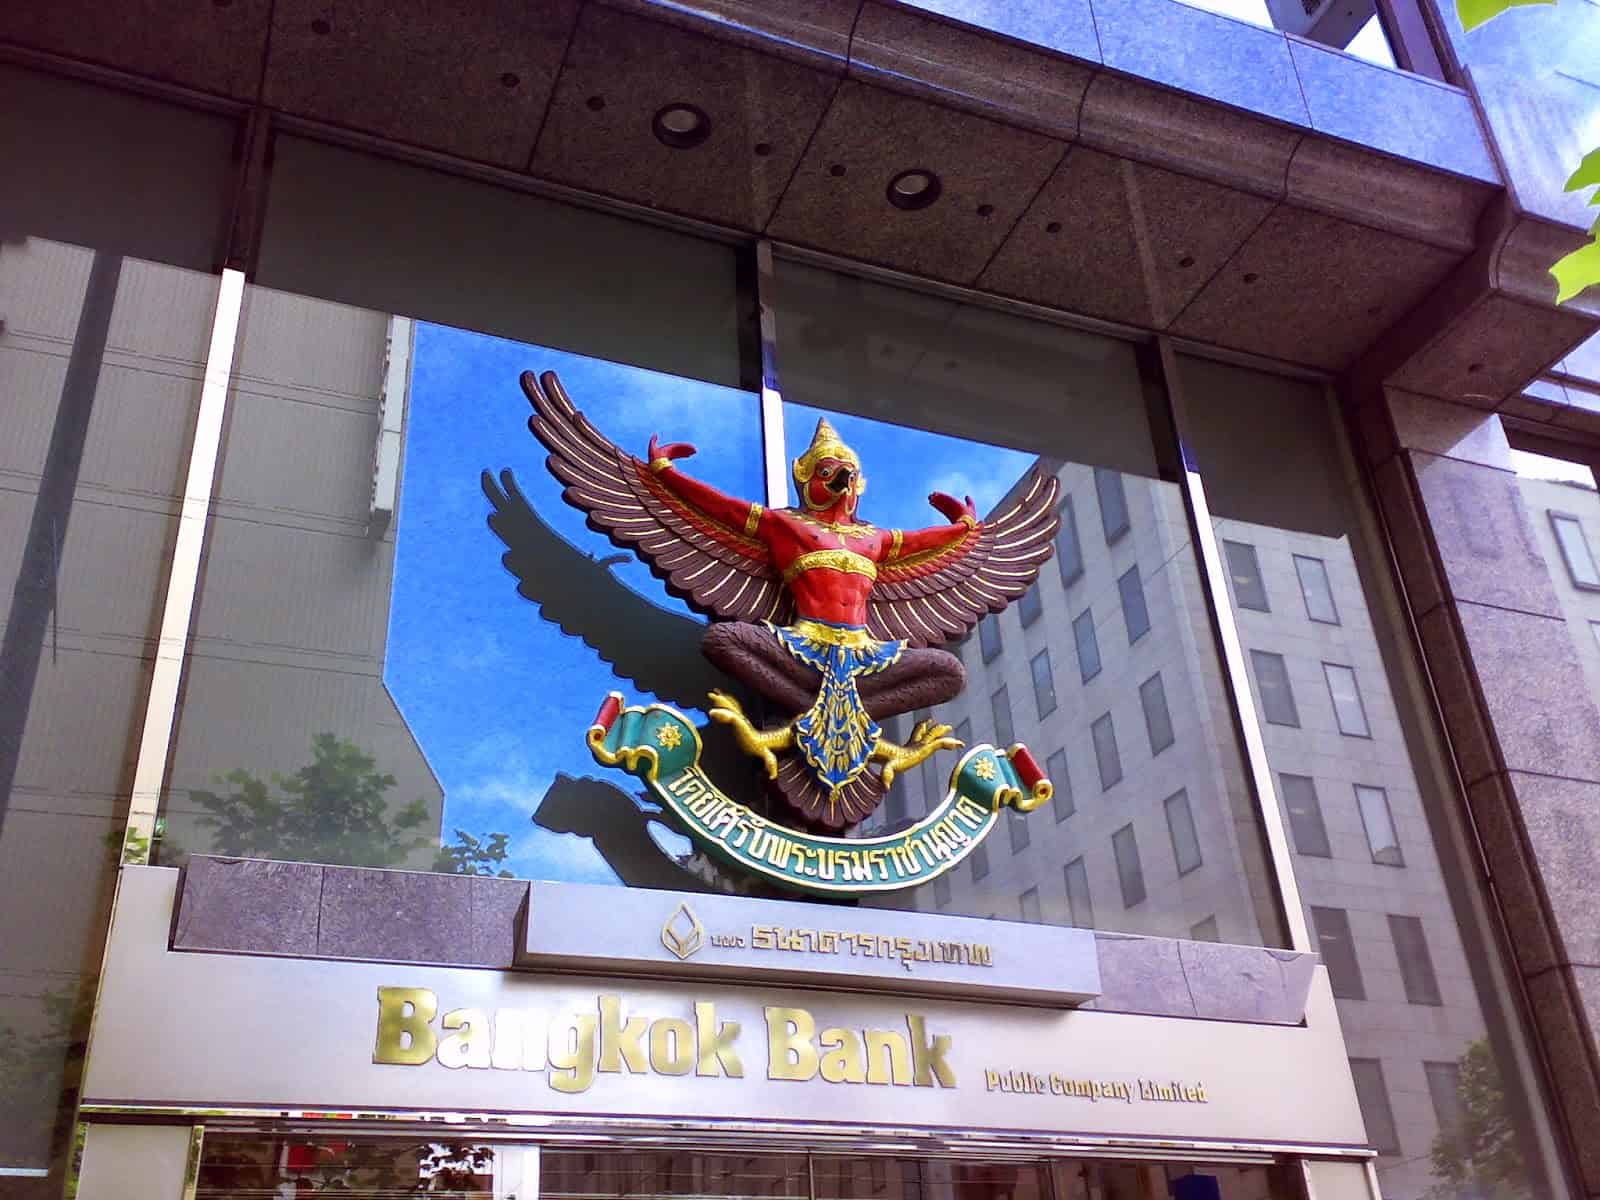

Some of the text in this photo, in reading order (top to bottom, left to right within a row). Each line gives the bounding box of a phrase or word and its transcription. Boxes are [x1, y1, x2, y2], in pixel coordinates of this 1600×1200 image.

[752, 923, 993, 971] ธนาคารกรุงเทพ
[372, 986, 956, 1093] Bangkok Bank
[984, 1068, 1209, 1104] Public Company Limited
